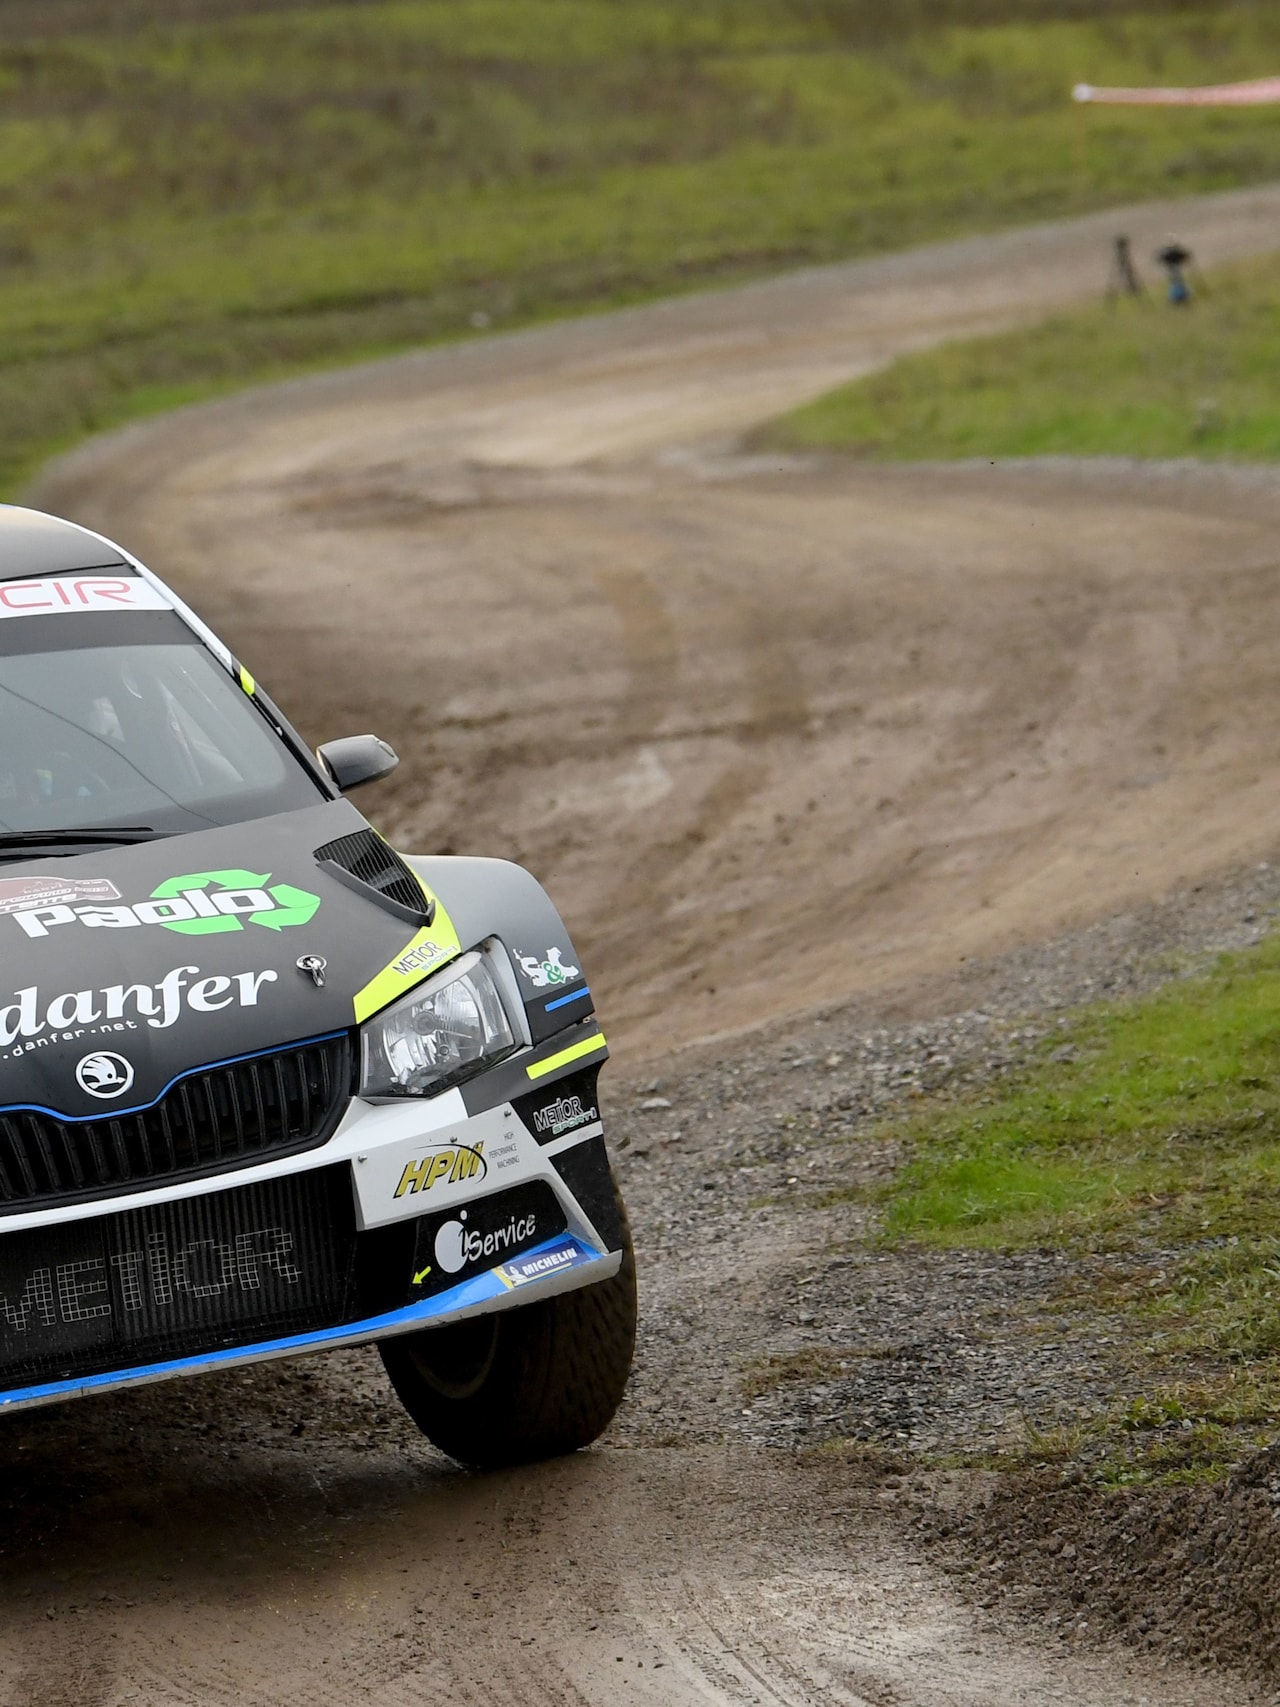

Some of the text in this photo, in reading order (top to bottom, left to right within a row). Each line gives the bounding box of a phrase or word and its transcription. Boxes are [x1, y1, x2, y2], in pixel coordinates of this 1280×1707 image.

[12, 889, 276, 938] Paolo
[393, 1140, 486, 1199] HPM
[521, 1247, 578, 1276] MICHELIN
